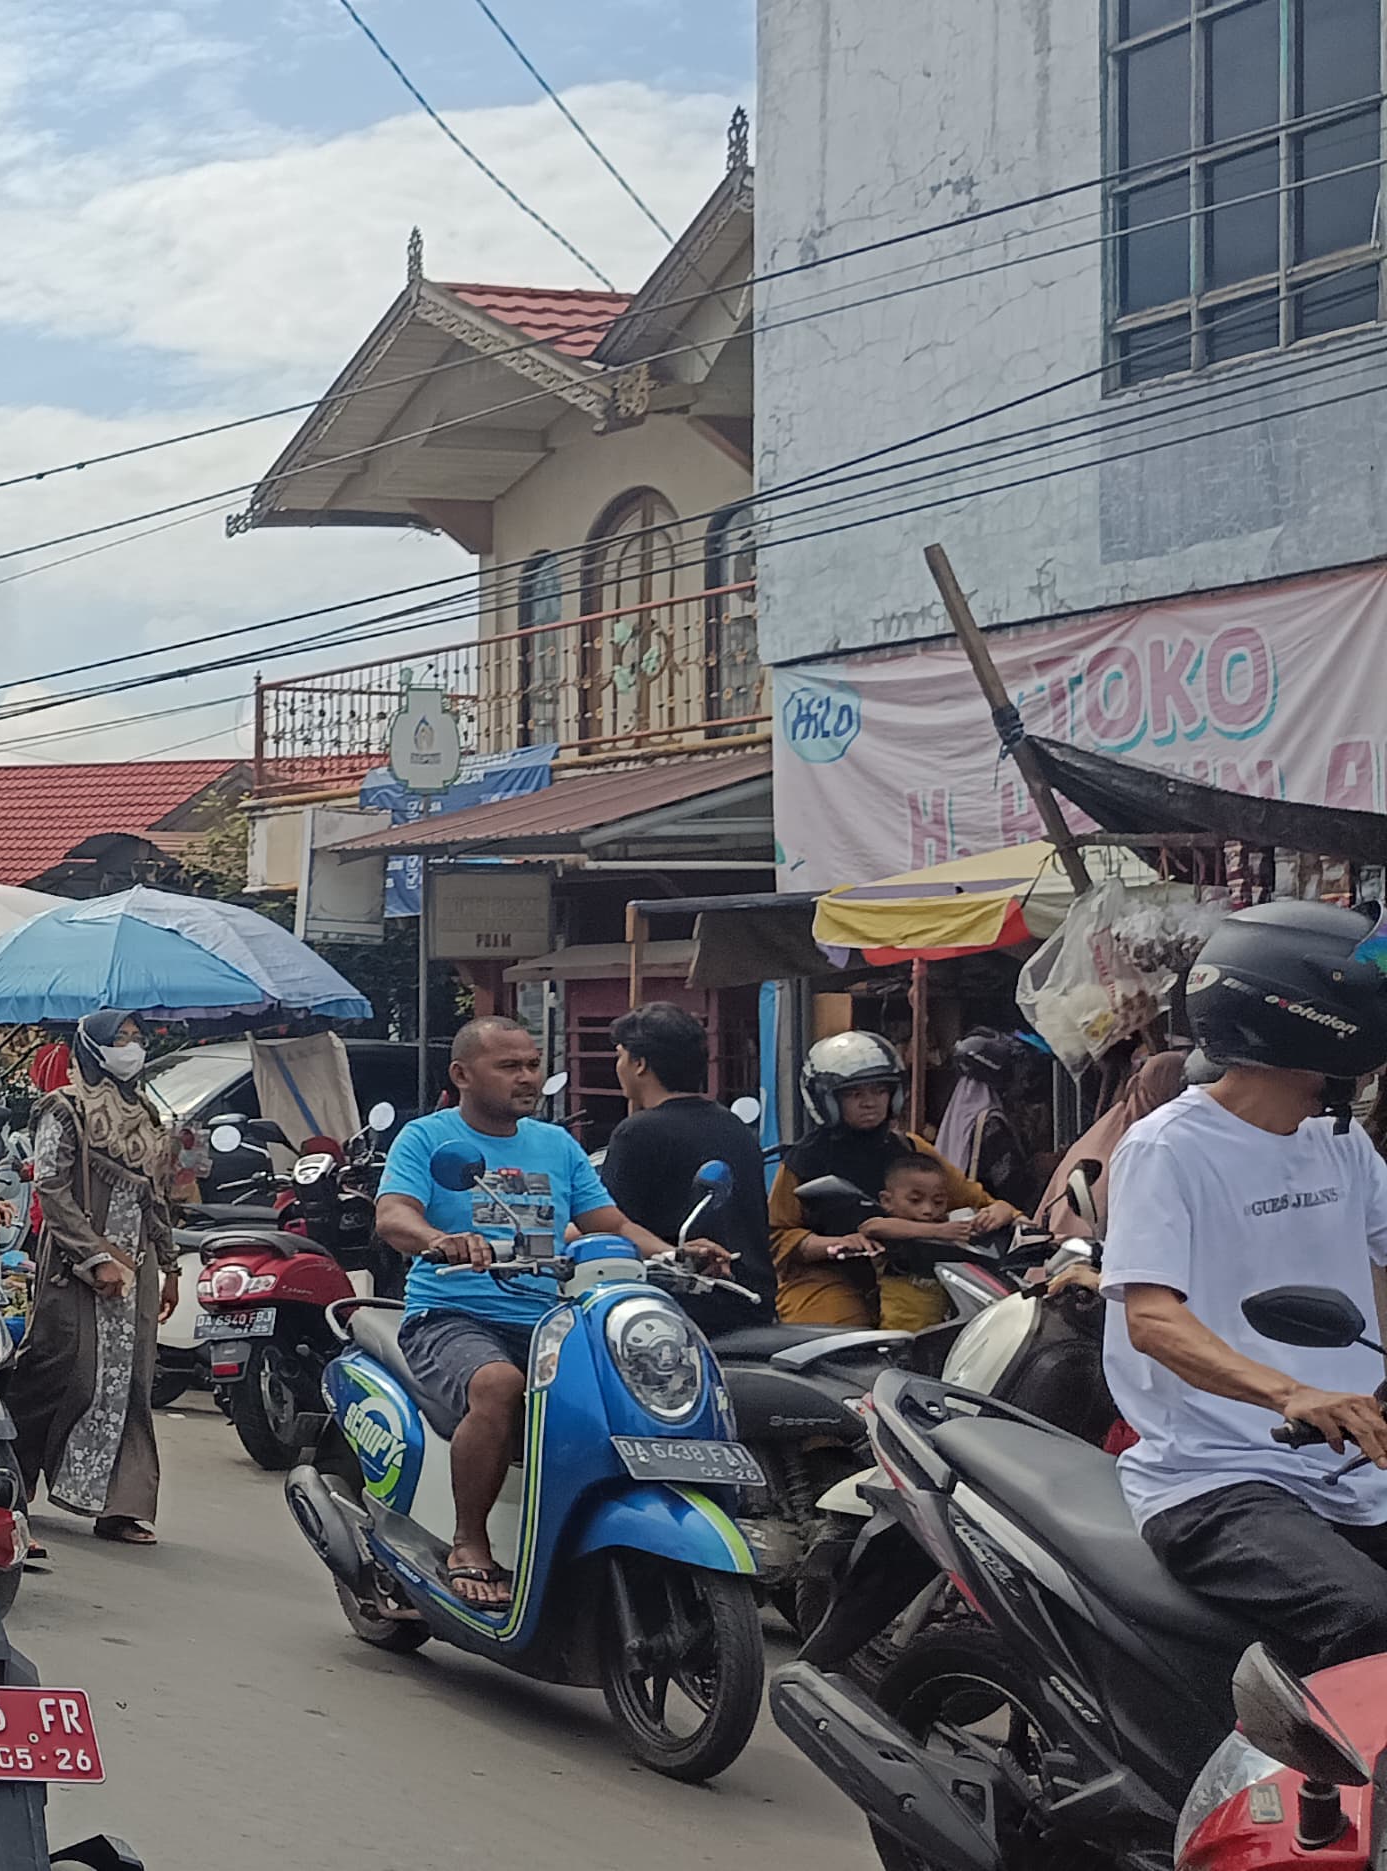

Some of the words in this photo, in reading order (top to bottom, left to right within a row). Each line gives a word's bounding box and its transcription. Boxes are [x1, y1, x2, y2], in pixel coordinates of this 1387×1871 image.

[1032, 624, 1279, 755] TOKO
[344, 1402, 408, 1468] SCOOPY
[618, 1440, 650, 1458] DA
[651, 1442, 706, 1462] 6438
[38, 1697, 84, 1735] FR
